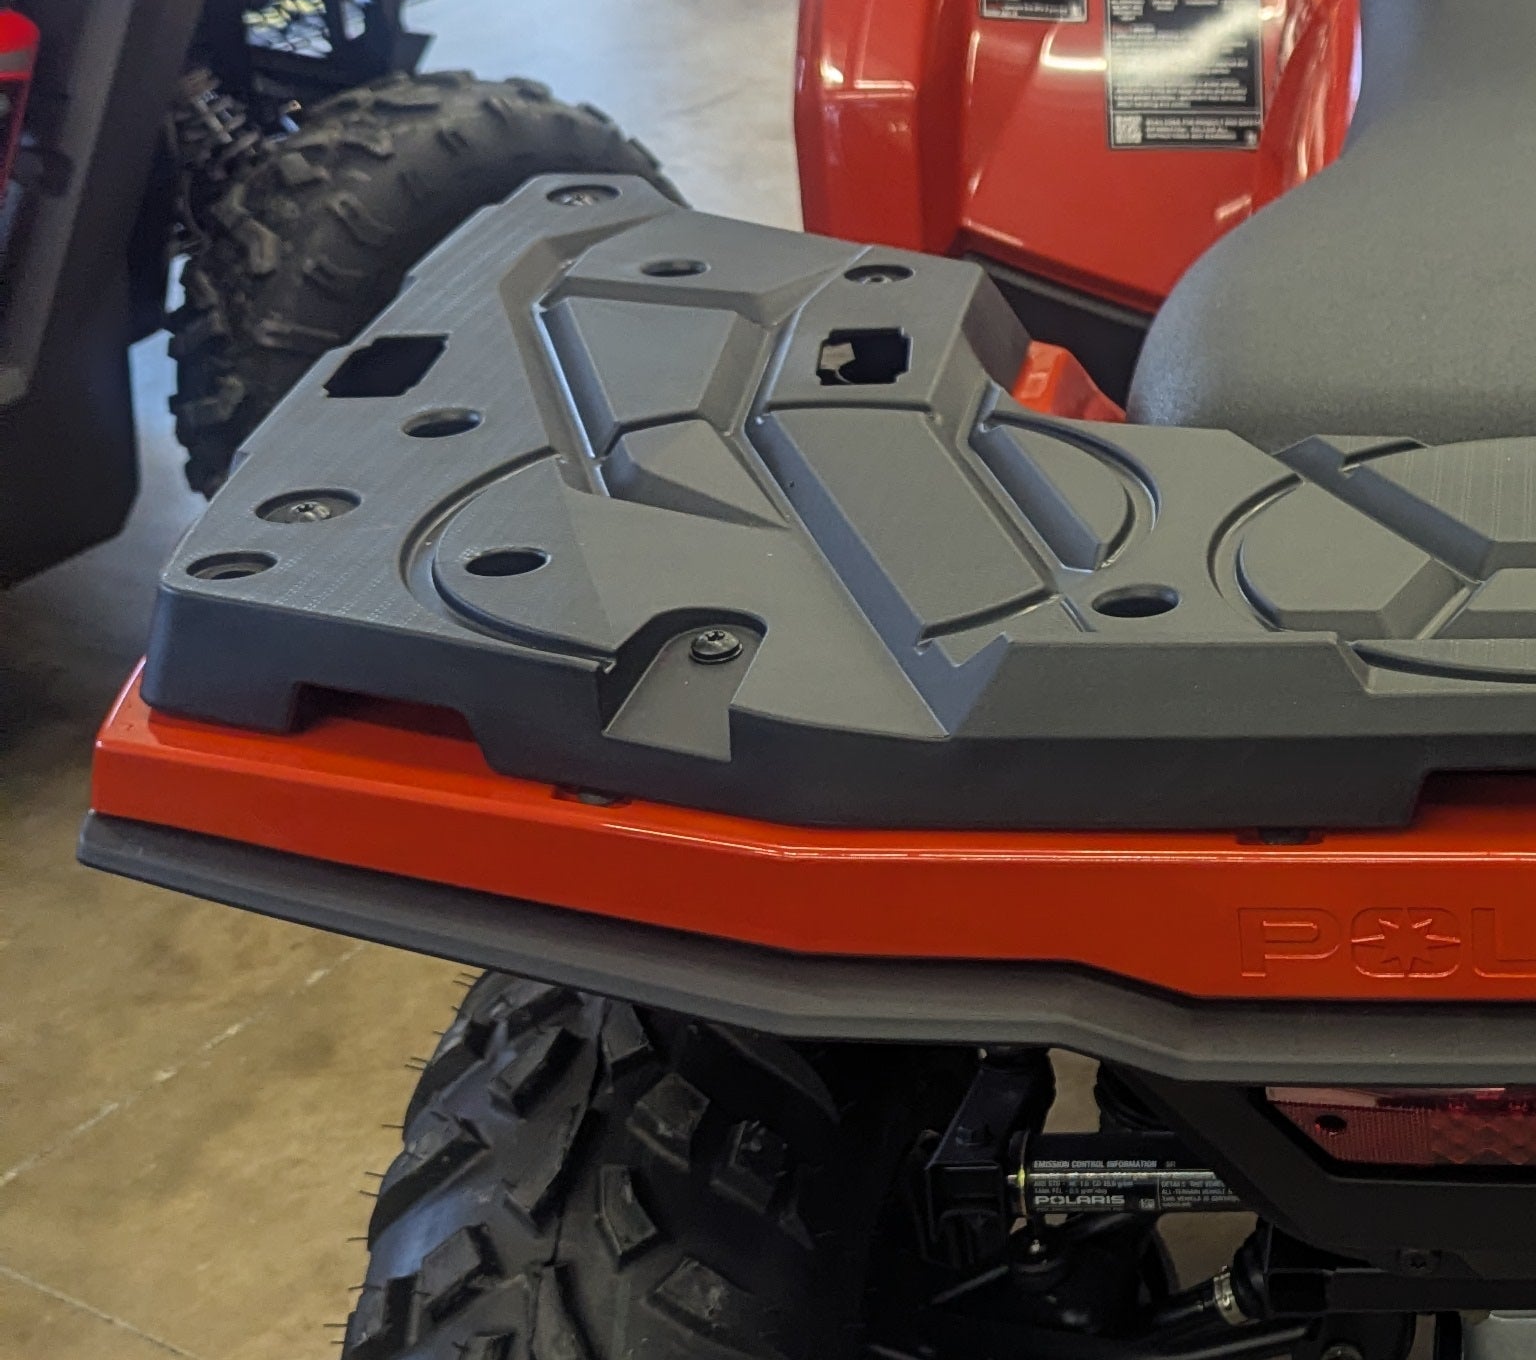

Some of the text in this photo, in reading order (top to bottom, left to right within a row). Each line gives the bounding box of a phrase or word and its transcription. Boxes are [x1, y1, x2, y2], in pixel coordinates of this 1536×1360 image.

[1034, 1160, 1157, 1168] EMISSION CONTROL INFORMATION
[1034, 1195, 1125, 1205] POLARIS
